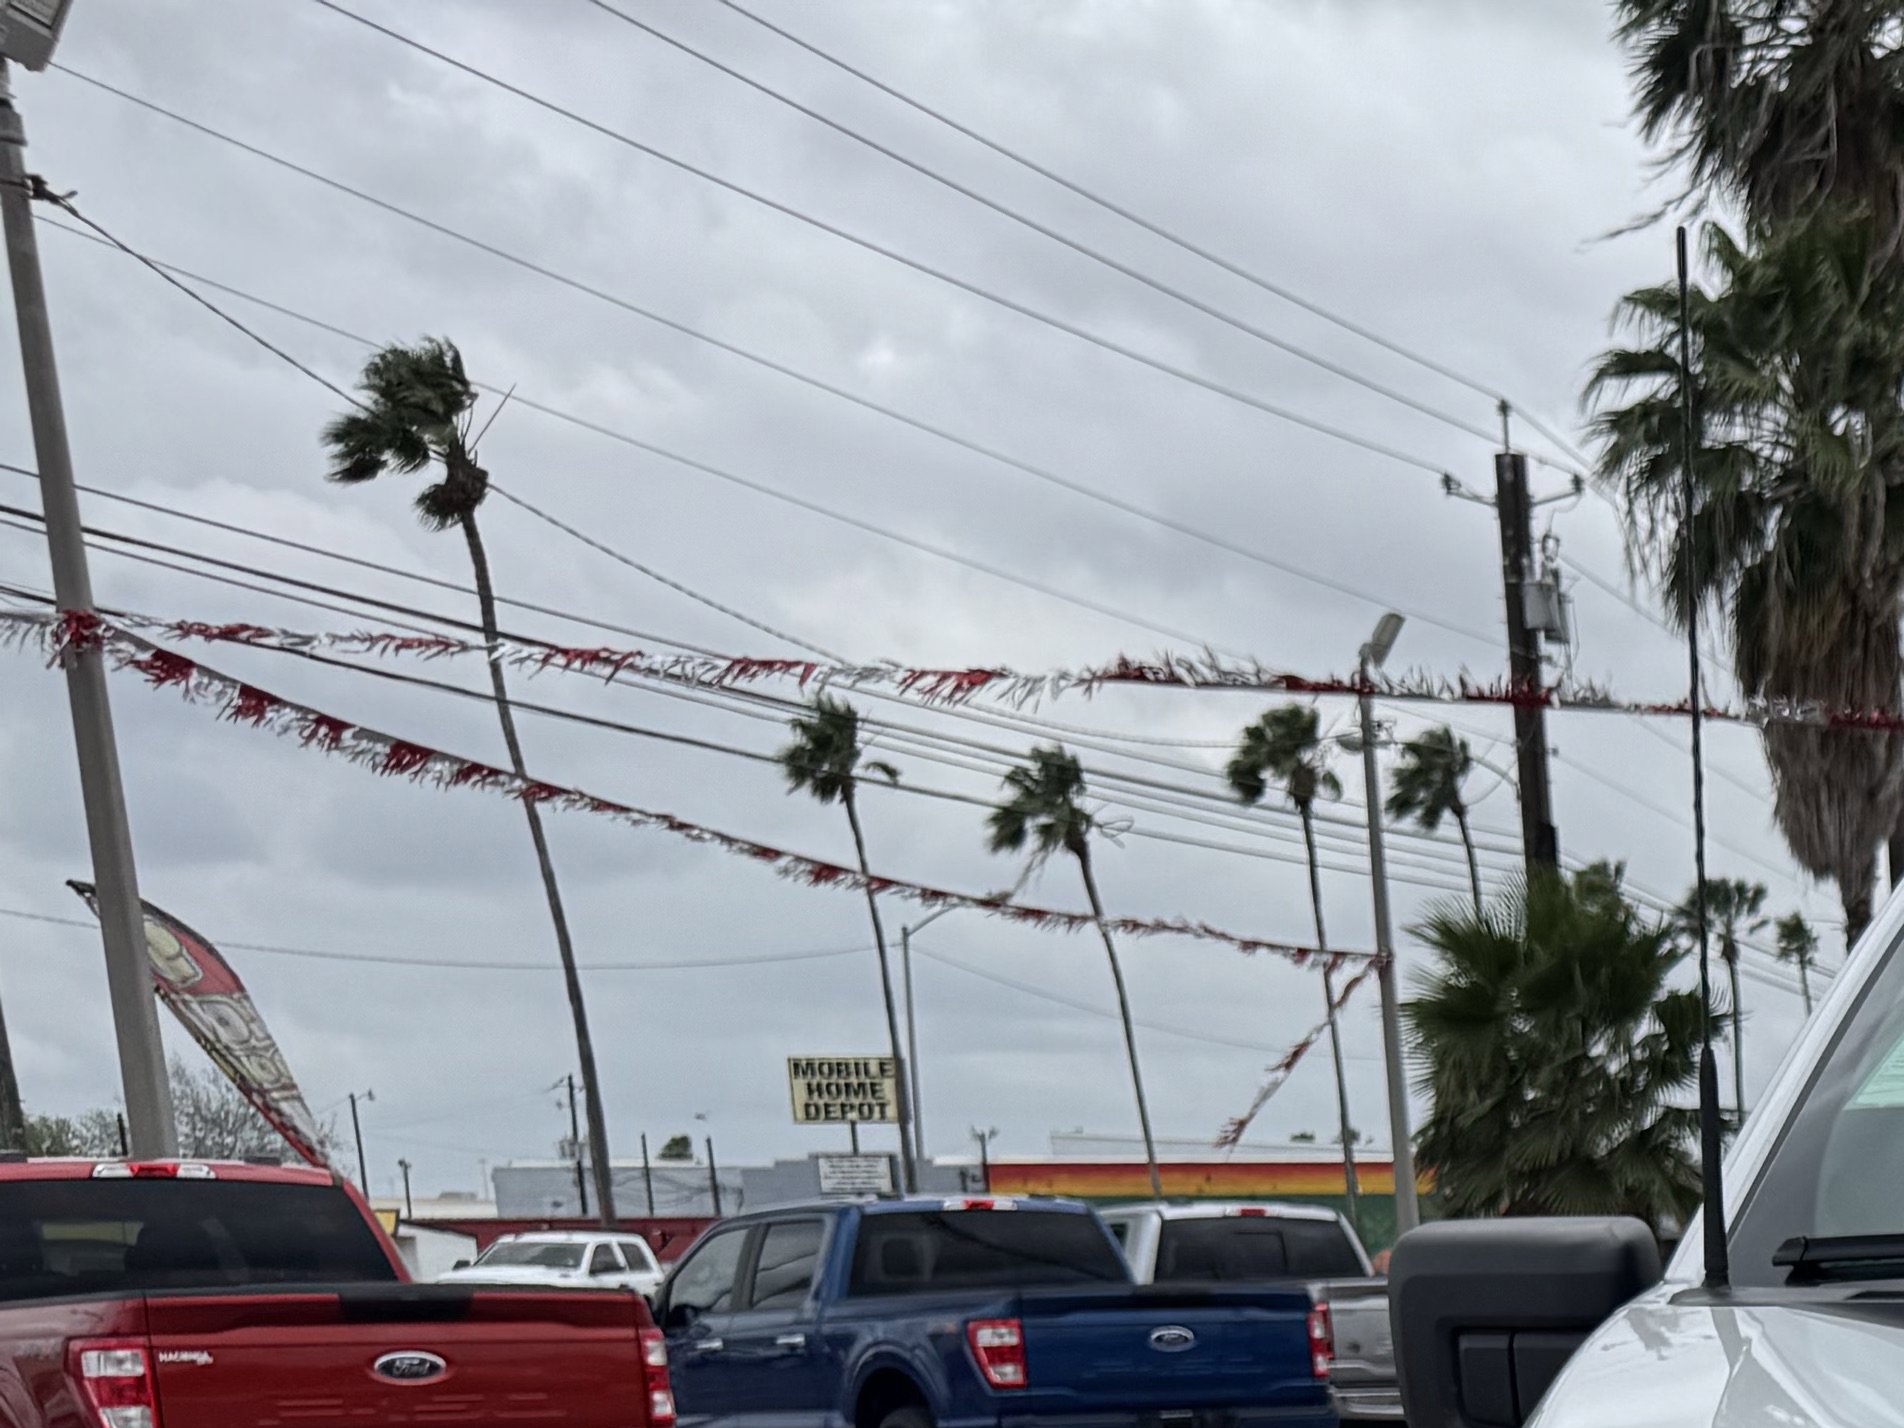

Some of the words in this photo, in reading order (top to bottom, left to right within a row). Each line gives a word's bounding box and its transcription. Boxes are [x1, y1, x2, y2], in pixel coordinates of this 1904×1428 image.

[793, 1061, 895, 1079] MOBILE
[806, 1081, 885, 1100] HOME
[804, 1102, 890, 1121] DEPOT
